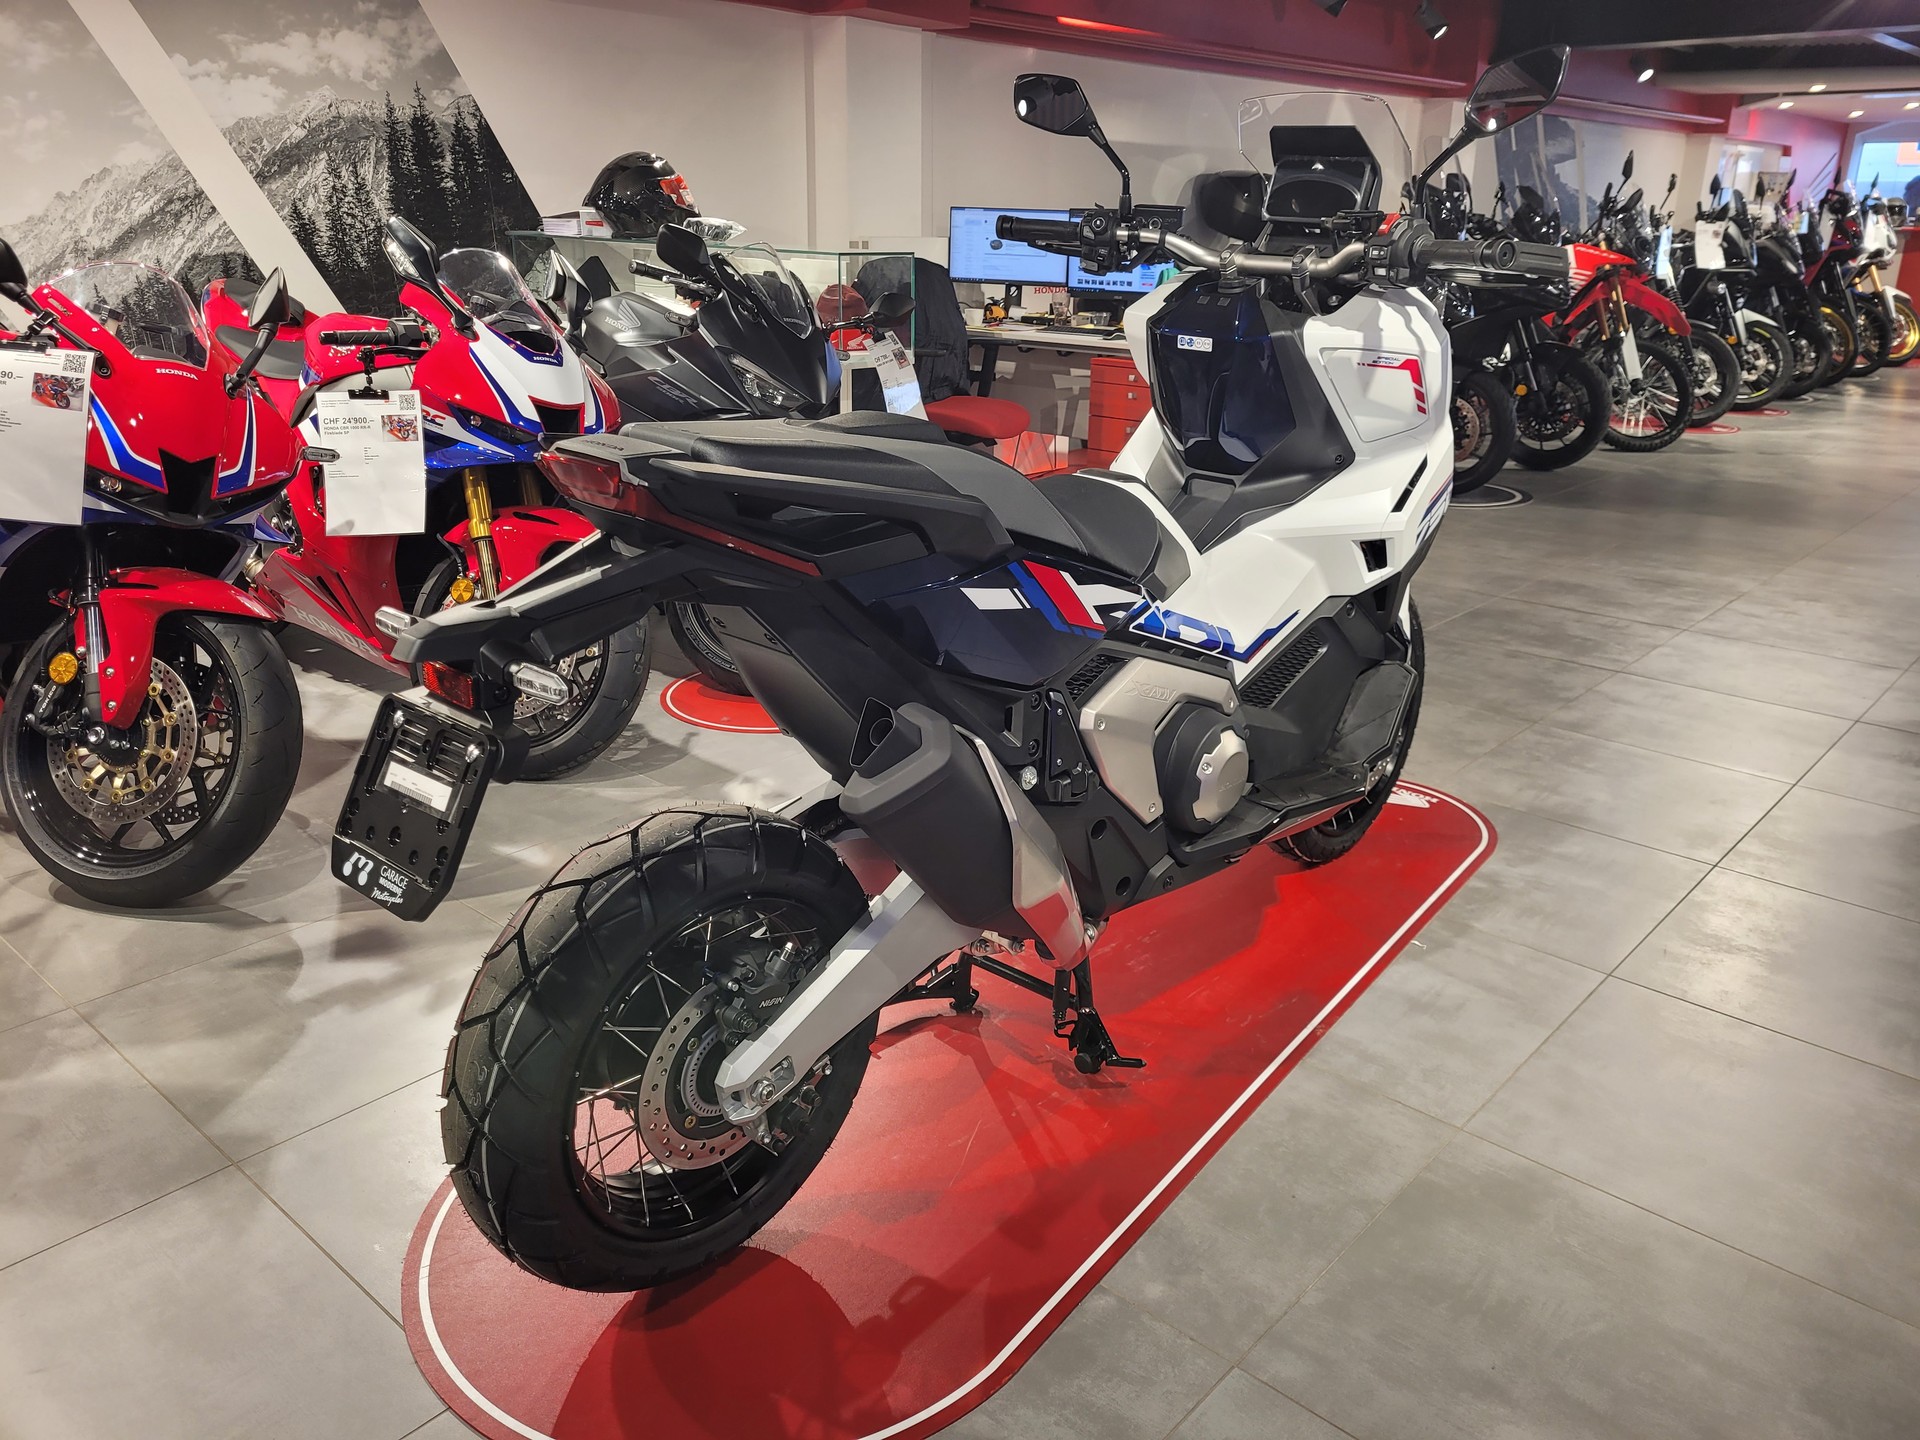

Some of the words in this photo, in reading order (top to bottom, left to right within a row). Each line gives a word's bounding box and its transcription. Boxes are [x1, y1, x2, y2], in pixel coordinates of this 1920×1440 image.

[1034, 286, 1068, 295] HONDA
[604, 315, 633, 335] HONDA
[533, 356, 559, 364] HONDA
[155, 367, 199, 381] HONDA
[323, 417, 340, 425] CHF
[290, 603, 380, 657] HONDA
[38, 684, 57, 713] TOKICO
[1124, 679, 1177, 704] X-ADV
[378, 876, 404, 895] MODERNE
[380, 865, 409, 890] GARAGE
[758, 995, 786, 1009] NISSIN
